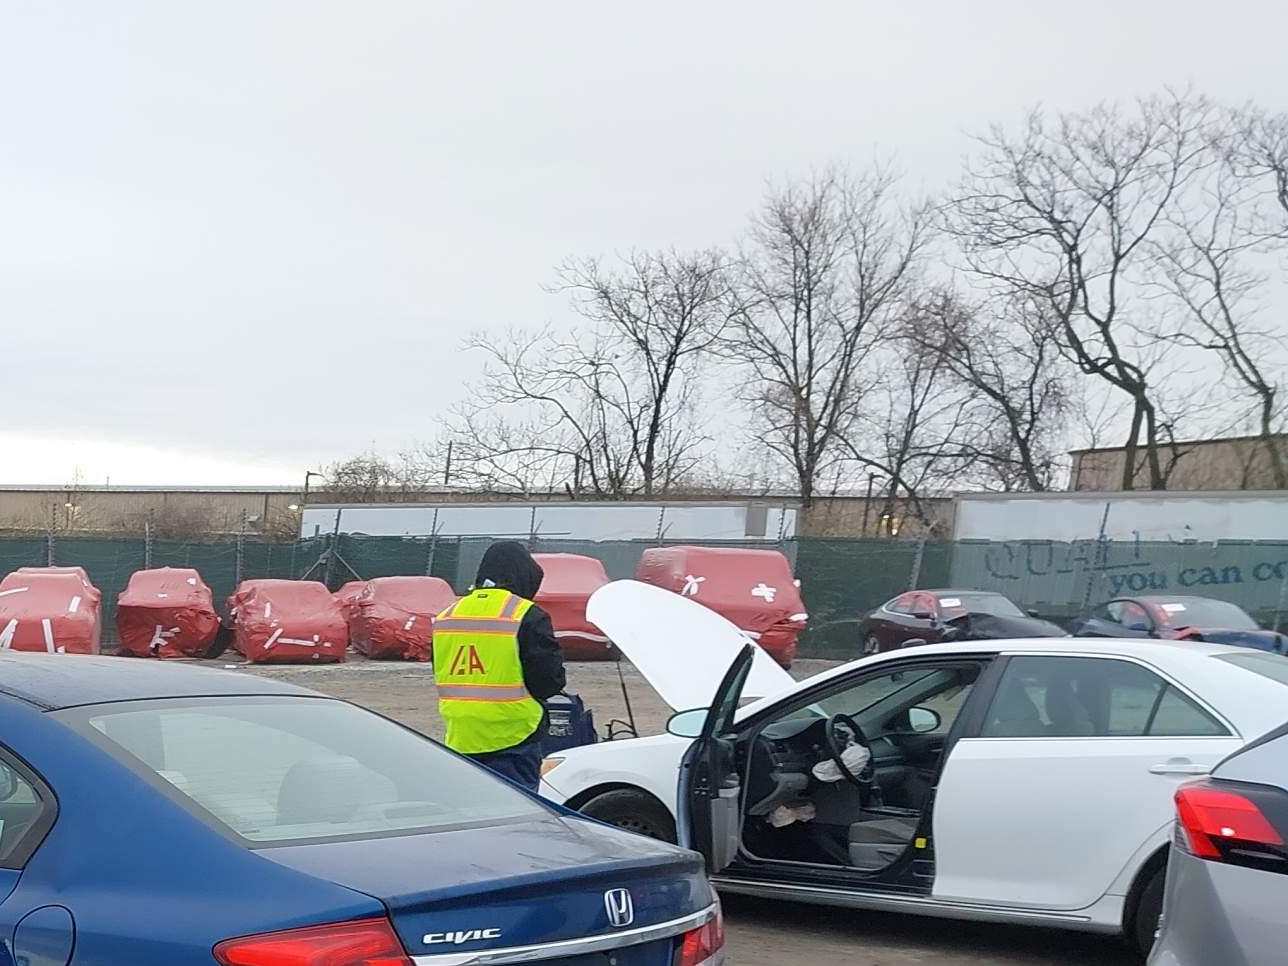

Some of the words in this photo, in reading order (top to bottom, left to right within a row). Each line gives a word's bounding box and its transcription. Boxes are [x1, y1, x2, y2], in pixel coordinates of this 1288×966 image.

[1108, 570, 1168, 597] you
[1177, 563, 1243, 587] can
[423, 928, 502, 944] CIVIC
